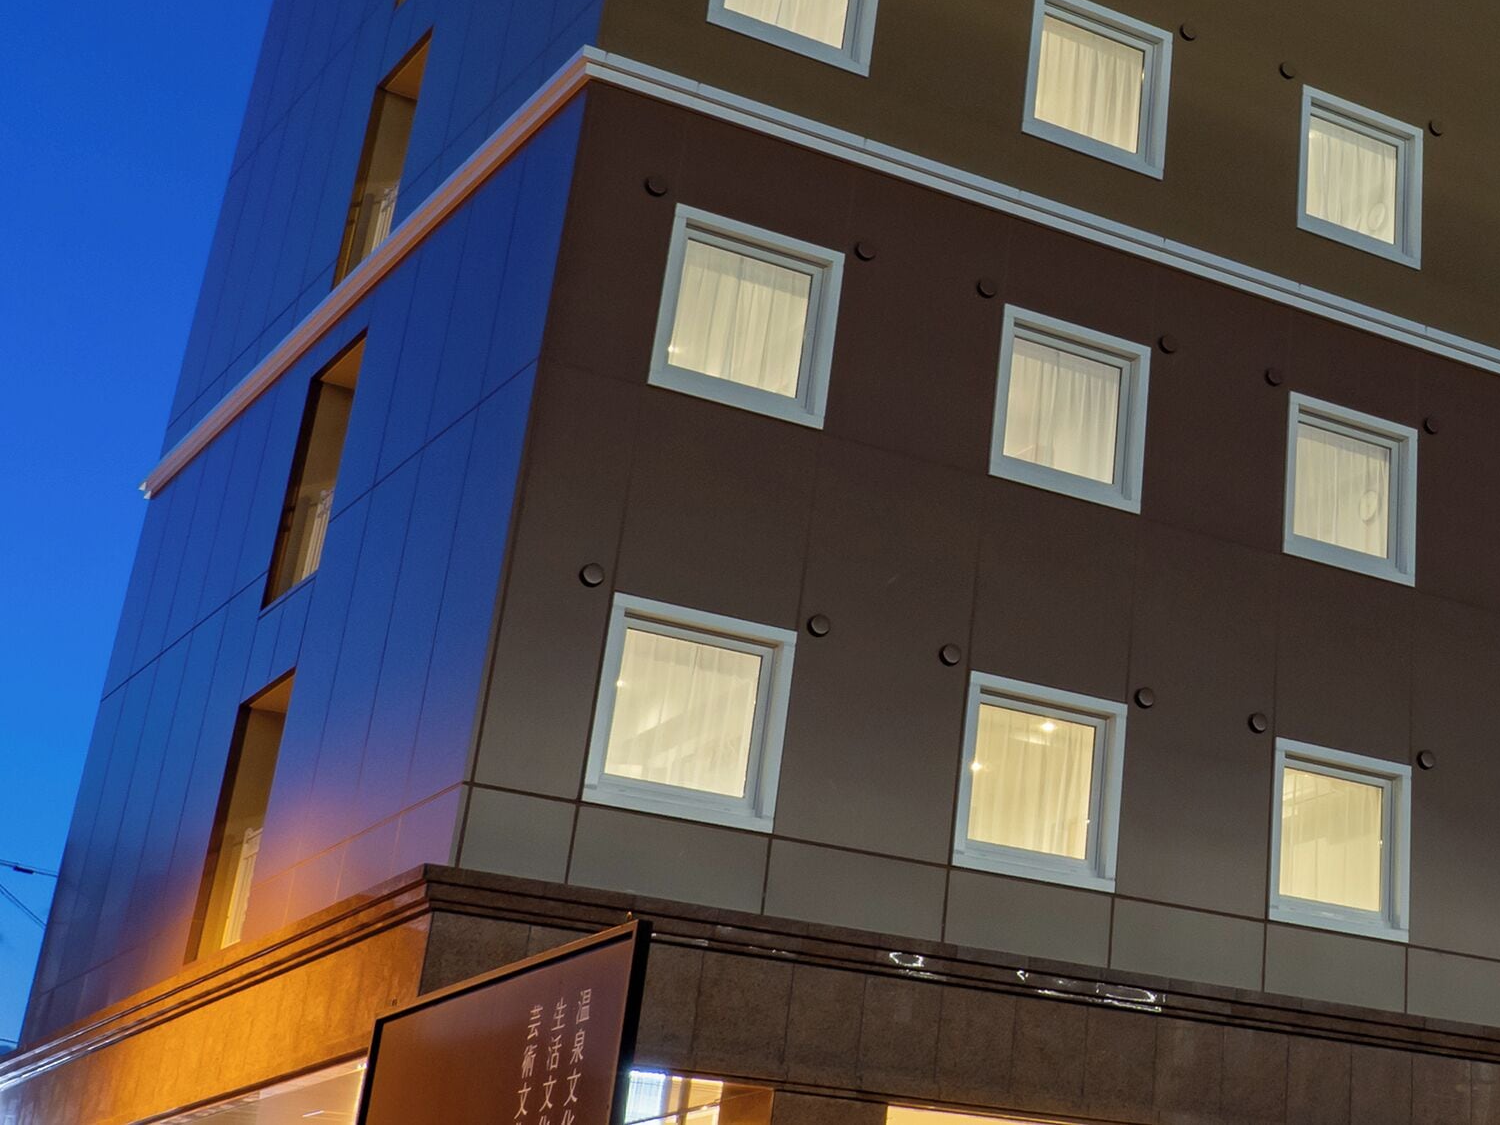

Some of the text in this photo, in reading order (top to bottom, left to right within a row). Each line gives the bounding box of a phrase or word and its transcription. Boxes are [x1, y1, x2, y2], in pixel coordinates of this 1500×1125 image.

[513, 1004, 543, 1125] 芸術文
[538, 997, 567, 1125] 生活文
